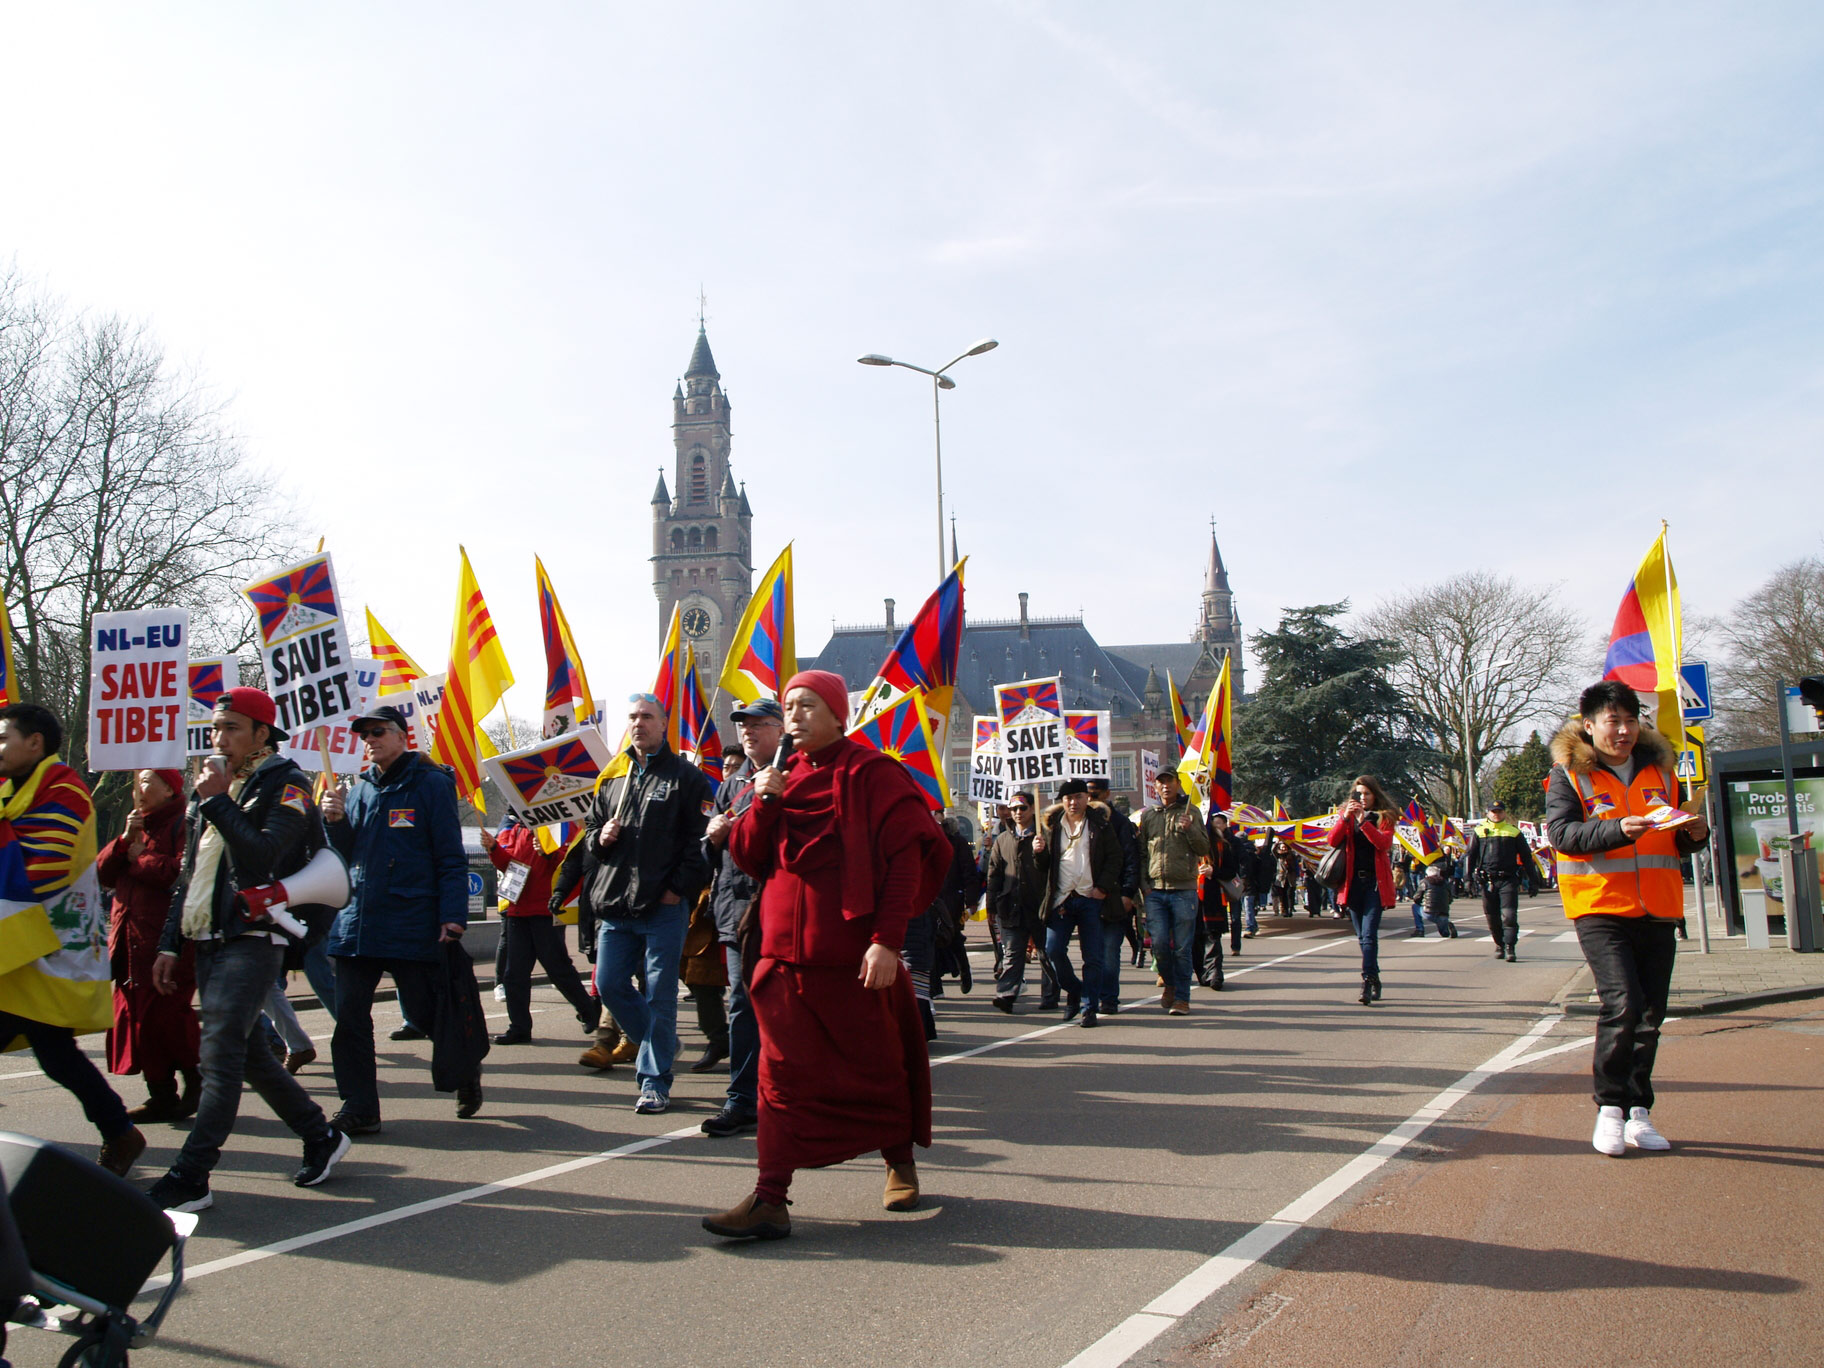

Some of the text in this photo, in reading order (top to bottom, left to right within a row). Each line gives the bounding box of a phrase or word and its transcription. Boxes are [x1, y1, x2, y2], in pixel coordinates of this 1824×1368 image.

[97, 624, 181, 651] NL-EU
[271, 628, 341, 687] SAVE
[101, 660, 177, 701] SAVE
[274, 672, 352, 731] TIBET
[96, 704, 180, 745] TIBET
[187, 727, 213, 750] TIB
[1006, 724, 1060, 754] SAVE
[975, 755, 1004, 777] SAV
[1006, 752, 1064, 781] TIBET
[1069, 759, 1108, 775] TIBET
[1747, 801, 1816, 816] nu grtis
[1749, 791, 1811, 804] Prober
[521, 800, 574, 827] SAVE
